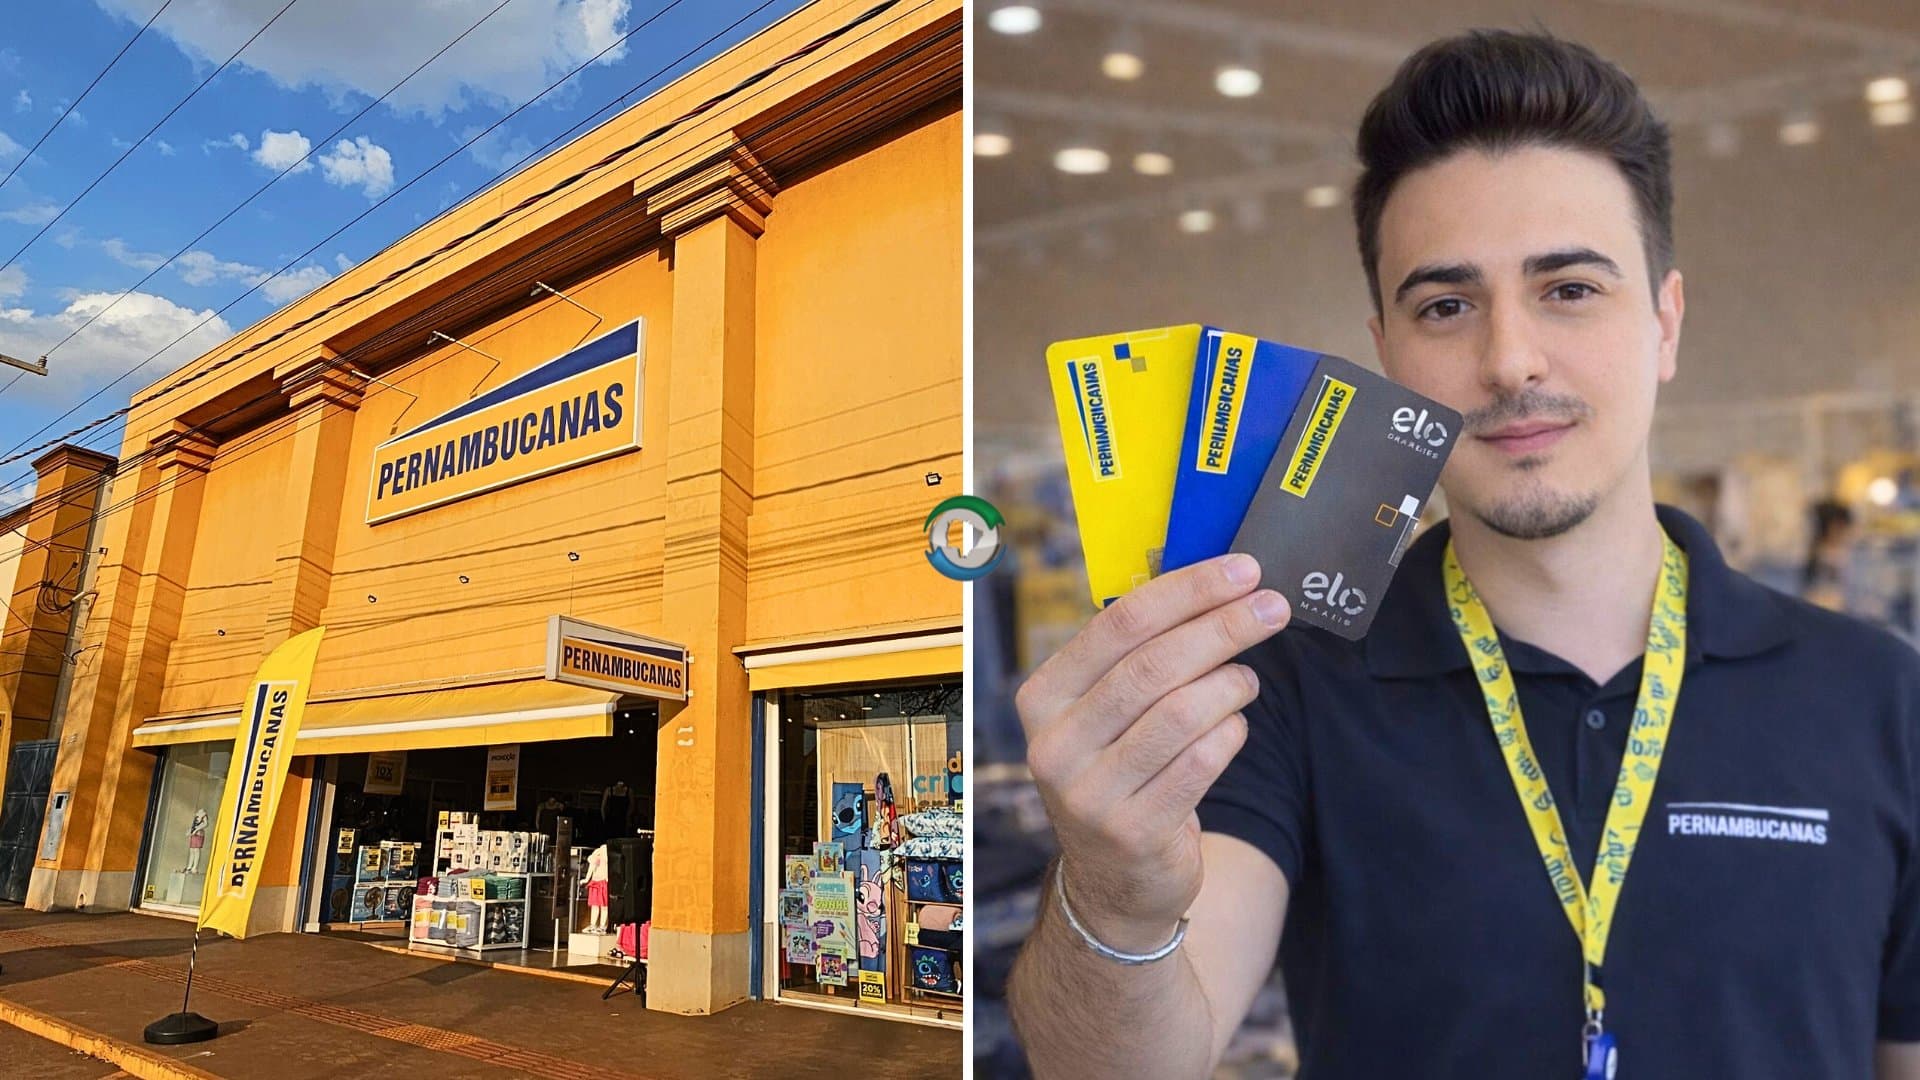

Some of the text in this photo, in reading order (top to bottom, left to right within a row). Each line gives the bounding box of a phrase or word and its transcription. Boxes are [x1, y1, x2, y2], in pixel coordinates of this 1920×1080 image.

[377, 382, 624, 500] PERNAMBUCANAS
[563, 645, 682, 690] PERNAMBUCANAS
[1668, 813, 1828, 845] PERNAMBUCANAS
